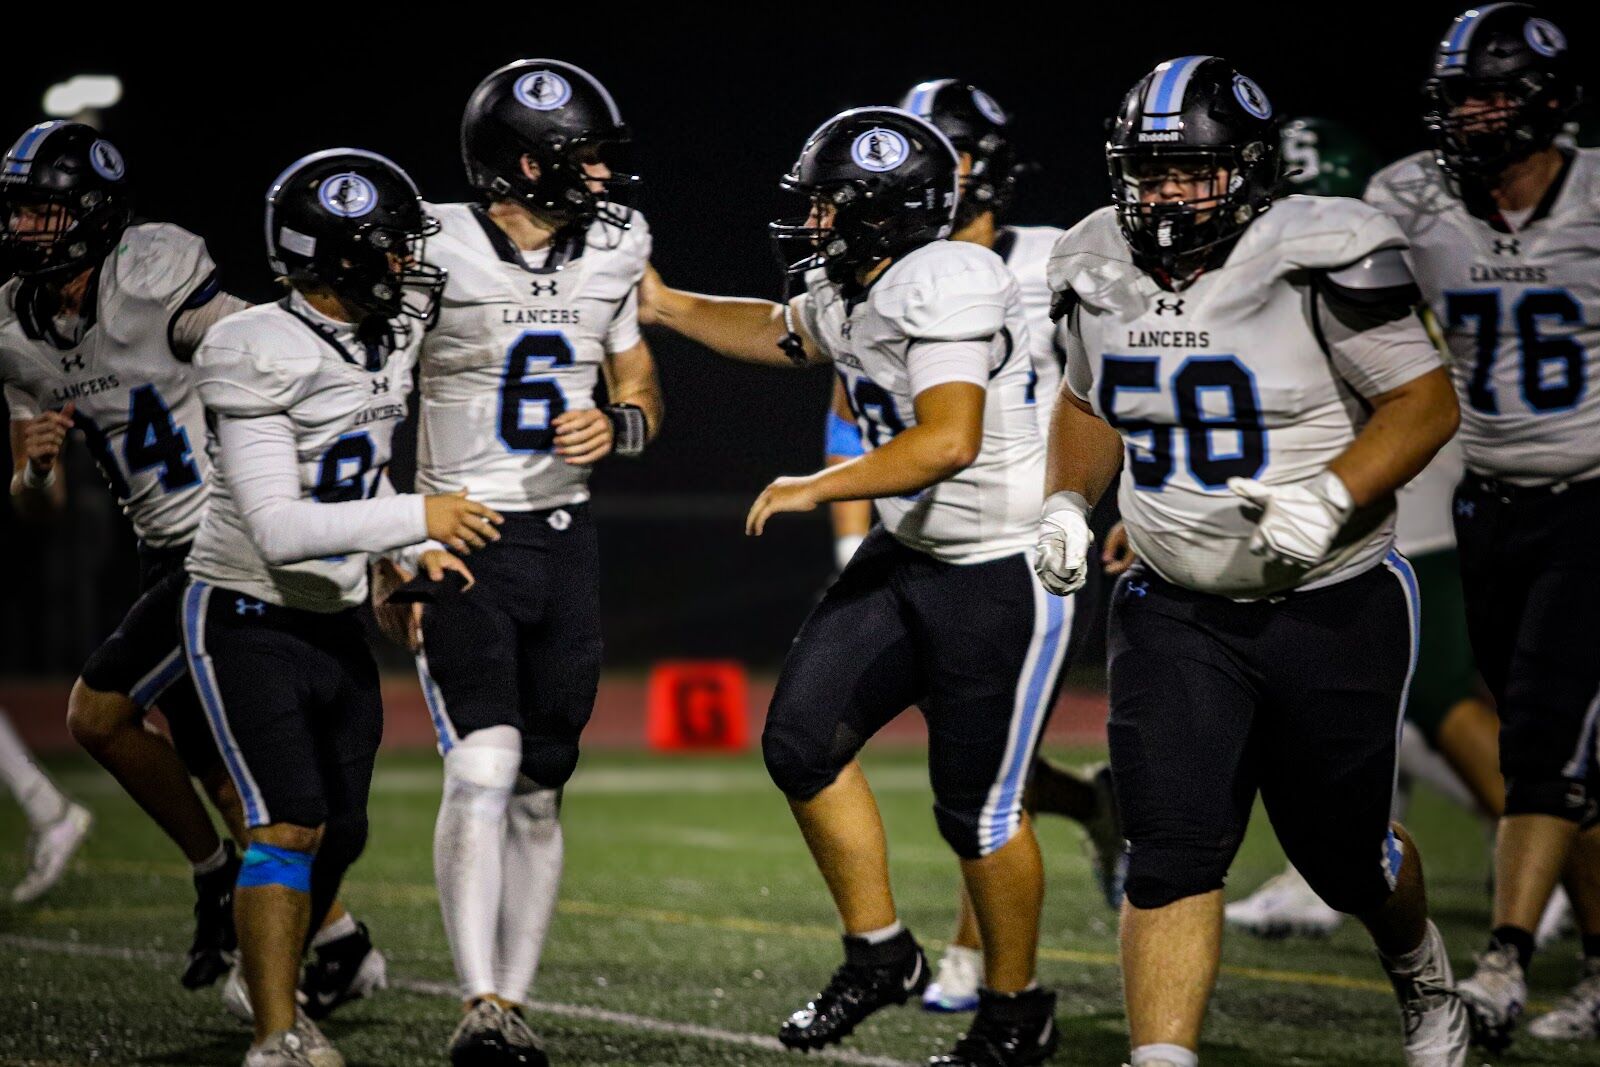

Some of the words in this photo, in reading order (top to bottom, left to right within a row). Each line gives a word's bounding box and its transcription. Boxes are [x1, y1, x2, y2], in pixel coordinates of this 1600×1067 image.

[1469, 266, 1548, 282] LANCERS
[502, 309, 581, 324] LANCERS
[1127, 331, 1210, 347] LANCERS
[1444, 288, 1588, 415] 76
[53, 374, 120, 402] LANCERS
[495, 329, 576, 455] 6
[1098, 353, 1270, 493] 58
[674, 679, 727, 745] G
